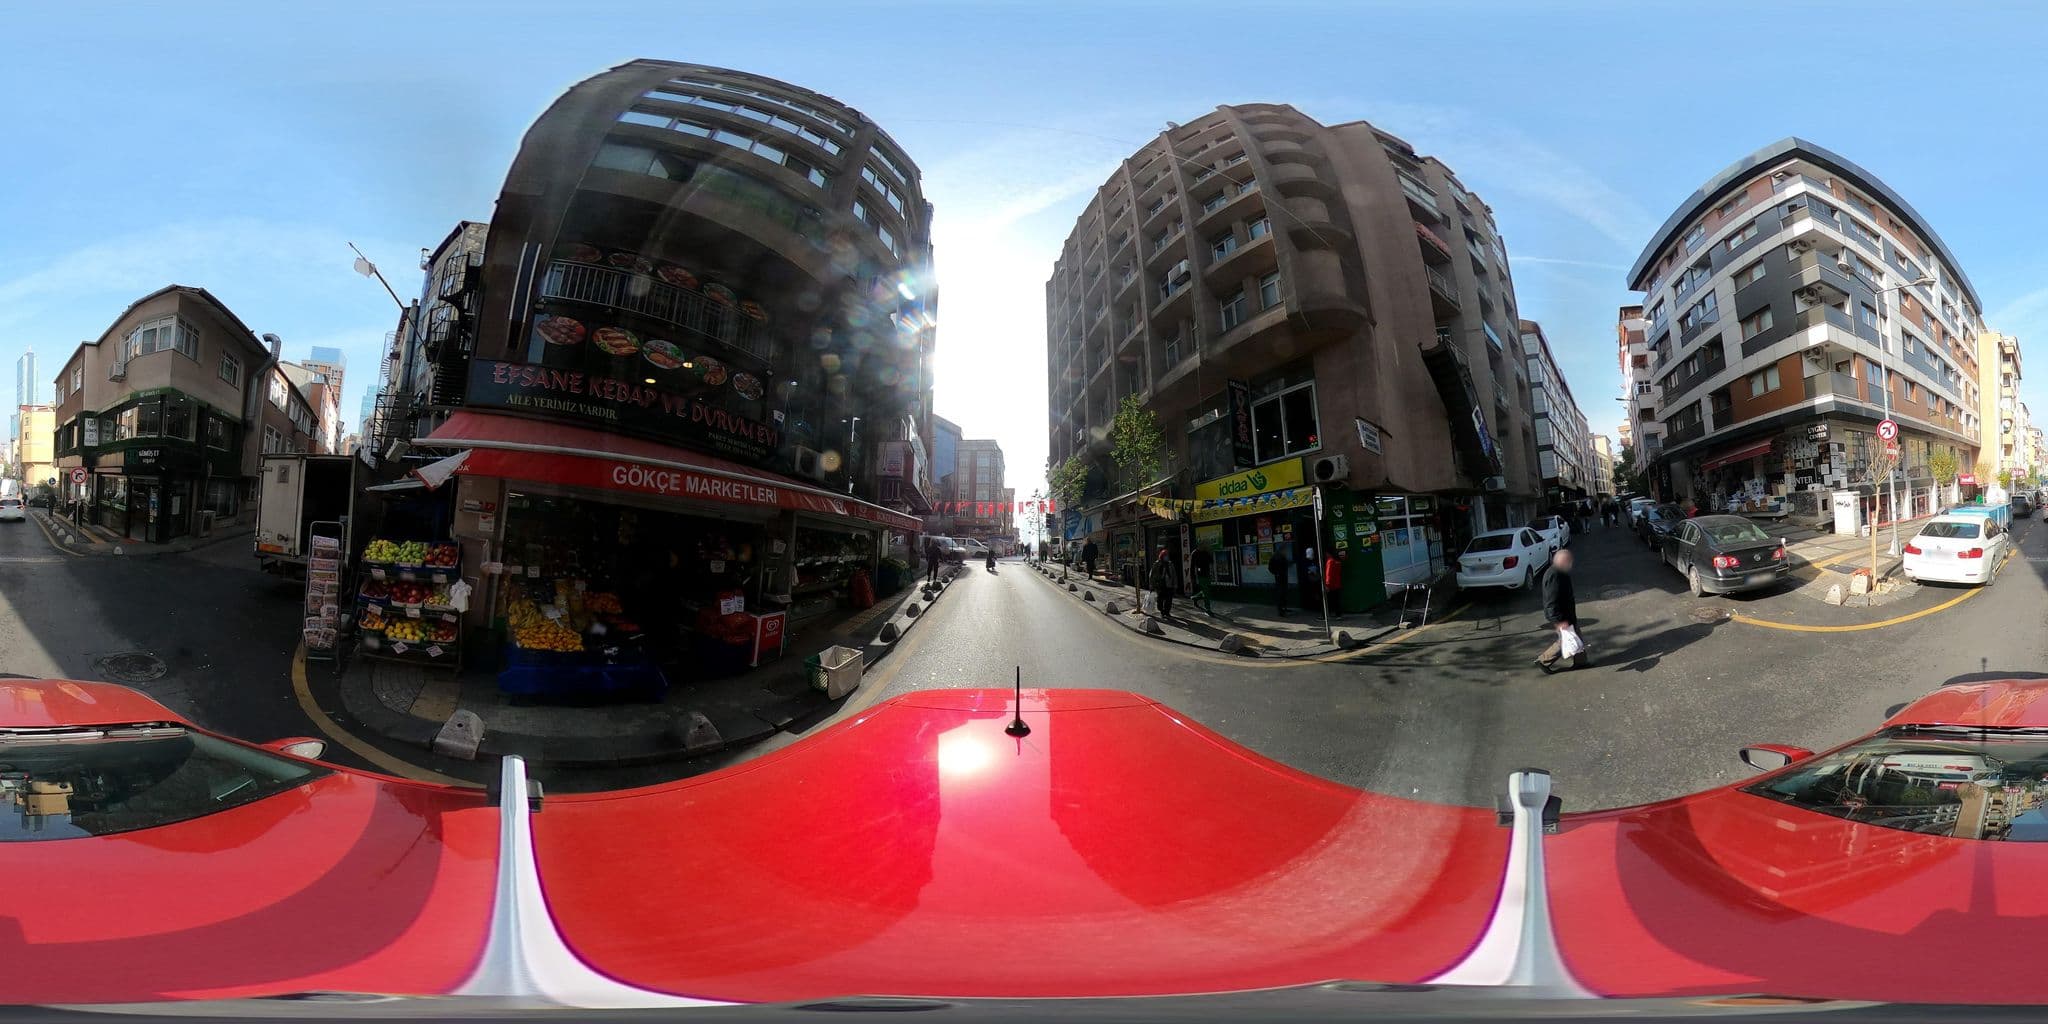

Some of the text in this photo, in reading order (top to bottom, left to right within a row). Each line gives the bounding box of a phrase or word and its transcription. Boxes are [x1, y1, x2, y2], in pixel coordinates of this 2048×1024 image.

[493, 362, 585, 395] EFSANE
[588, 376, 658, 409] KEBAP
[661, 392, 688, 418] VE
[579, 402, 617, 421] VARDIR
[612, 465, 777, 505] GÖKÇE MARKETLERİ
[1219, 478, 1248, 497] iddaa
